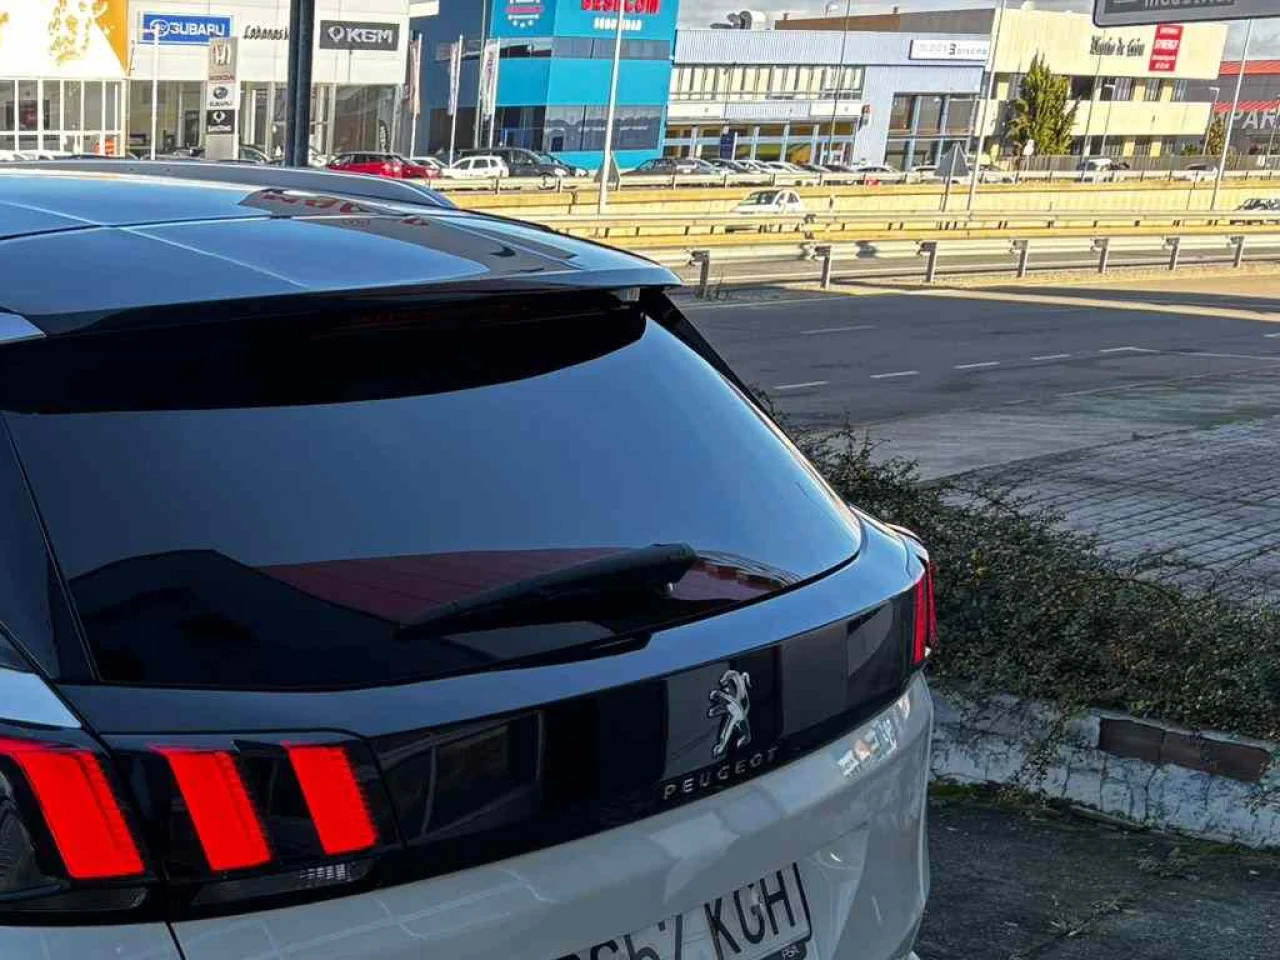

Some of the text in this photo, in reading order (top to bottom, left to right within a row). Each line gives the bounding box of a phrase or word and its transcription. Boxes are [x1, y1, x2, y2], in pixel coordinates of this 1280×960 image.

[169, 21, 225, 37] SUBARU
[347, 28, 393, 44] KGM
[664, 746, 779, 800] PEUGEOT
